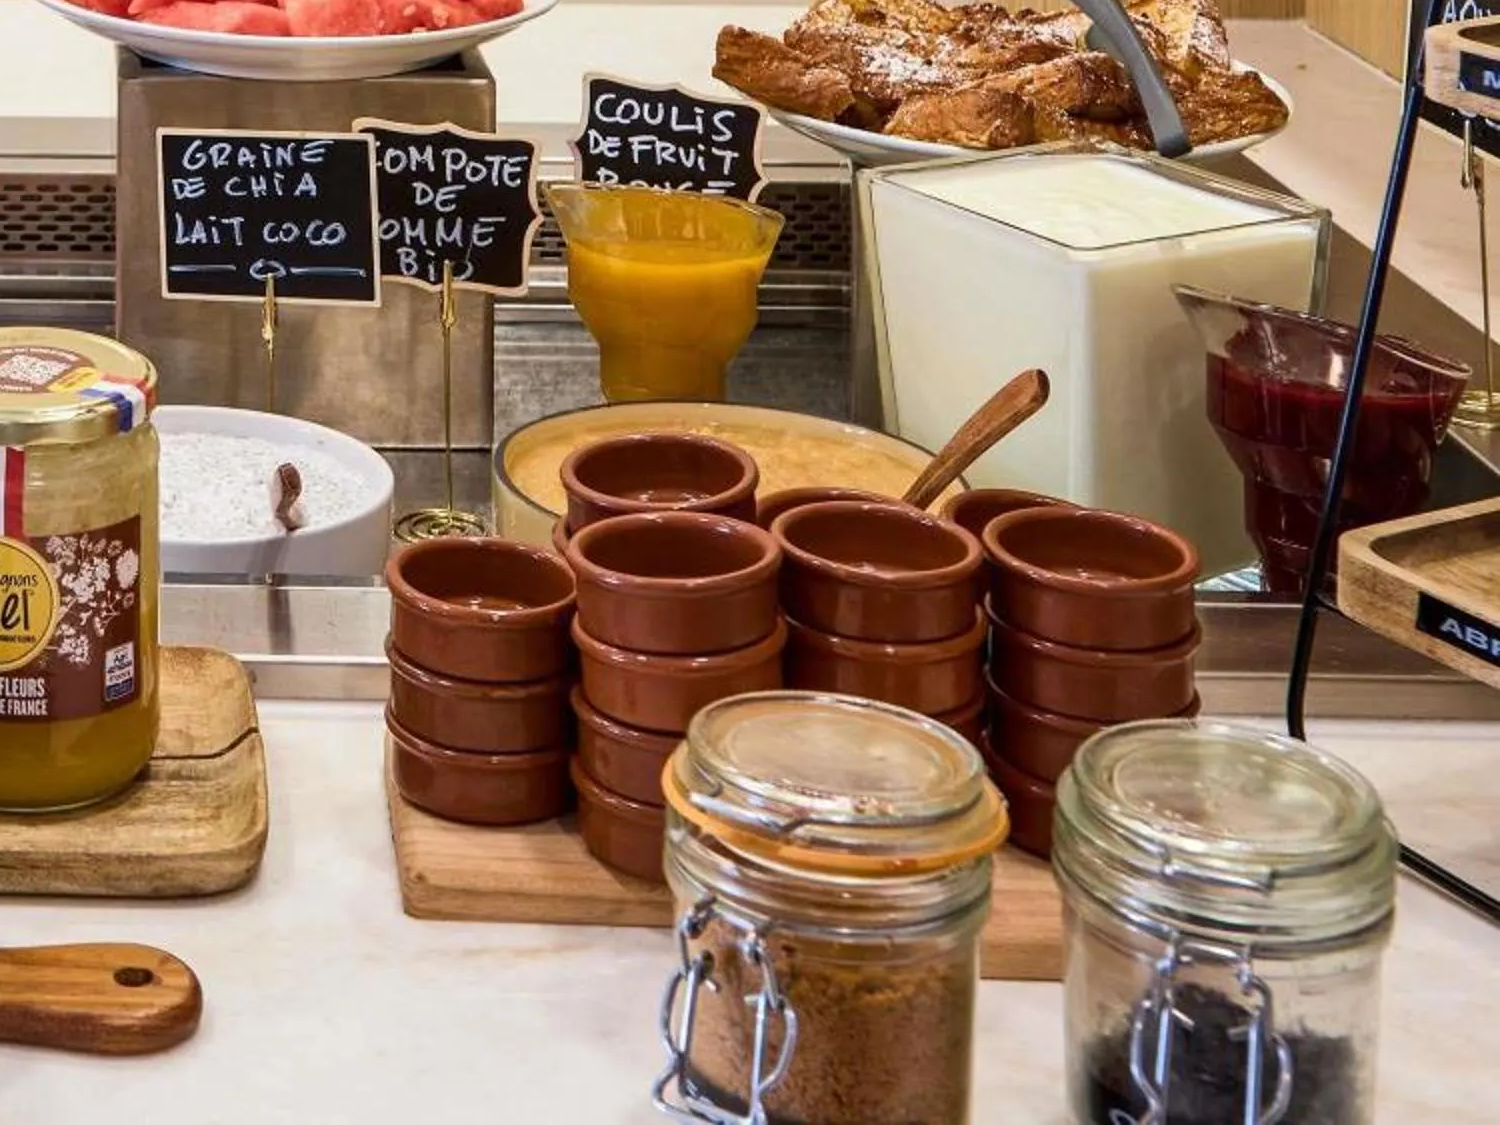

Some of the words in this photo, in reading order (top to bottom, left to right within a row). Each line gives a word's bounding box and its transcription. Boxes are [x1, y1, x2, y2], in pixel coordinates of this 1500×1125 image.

[588, 129, 621, 158] DE
[376, 141, 528, 187] OMPOTE
[171, 176, 207, 200] DE
[412, 181, 467, 212] DE
[379, 216, 506, 247] OMME
[7, 698, 49, 716] FRANCE
